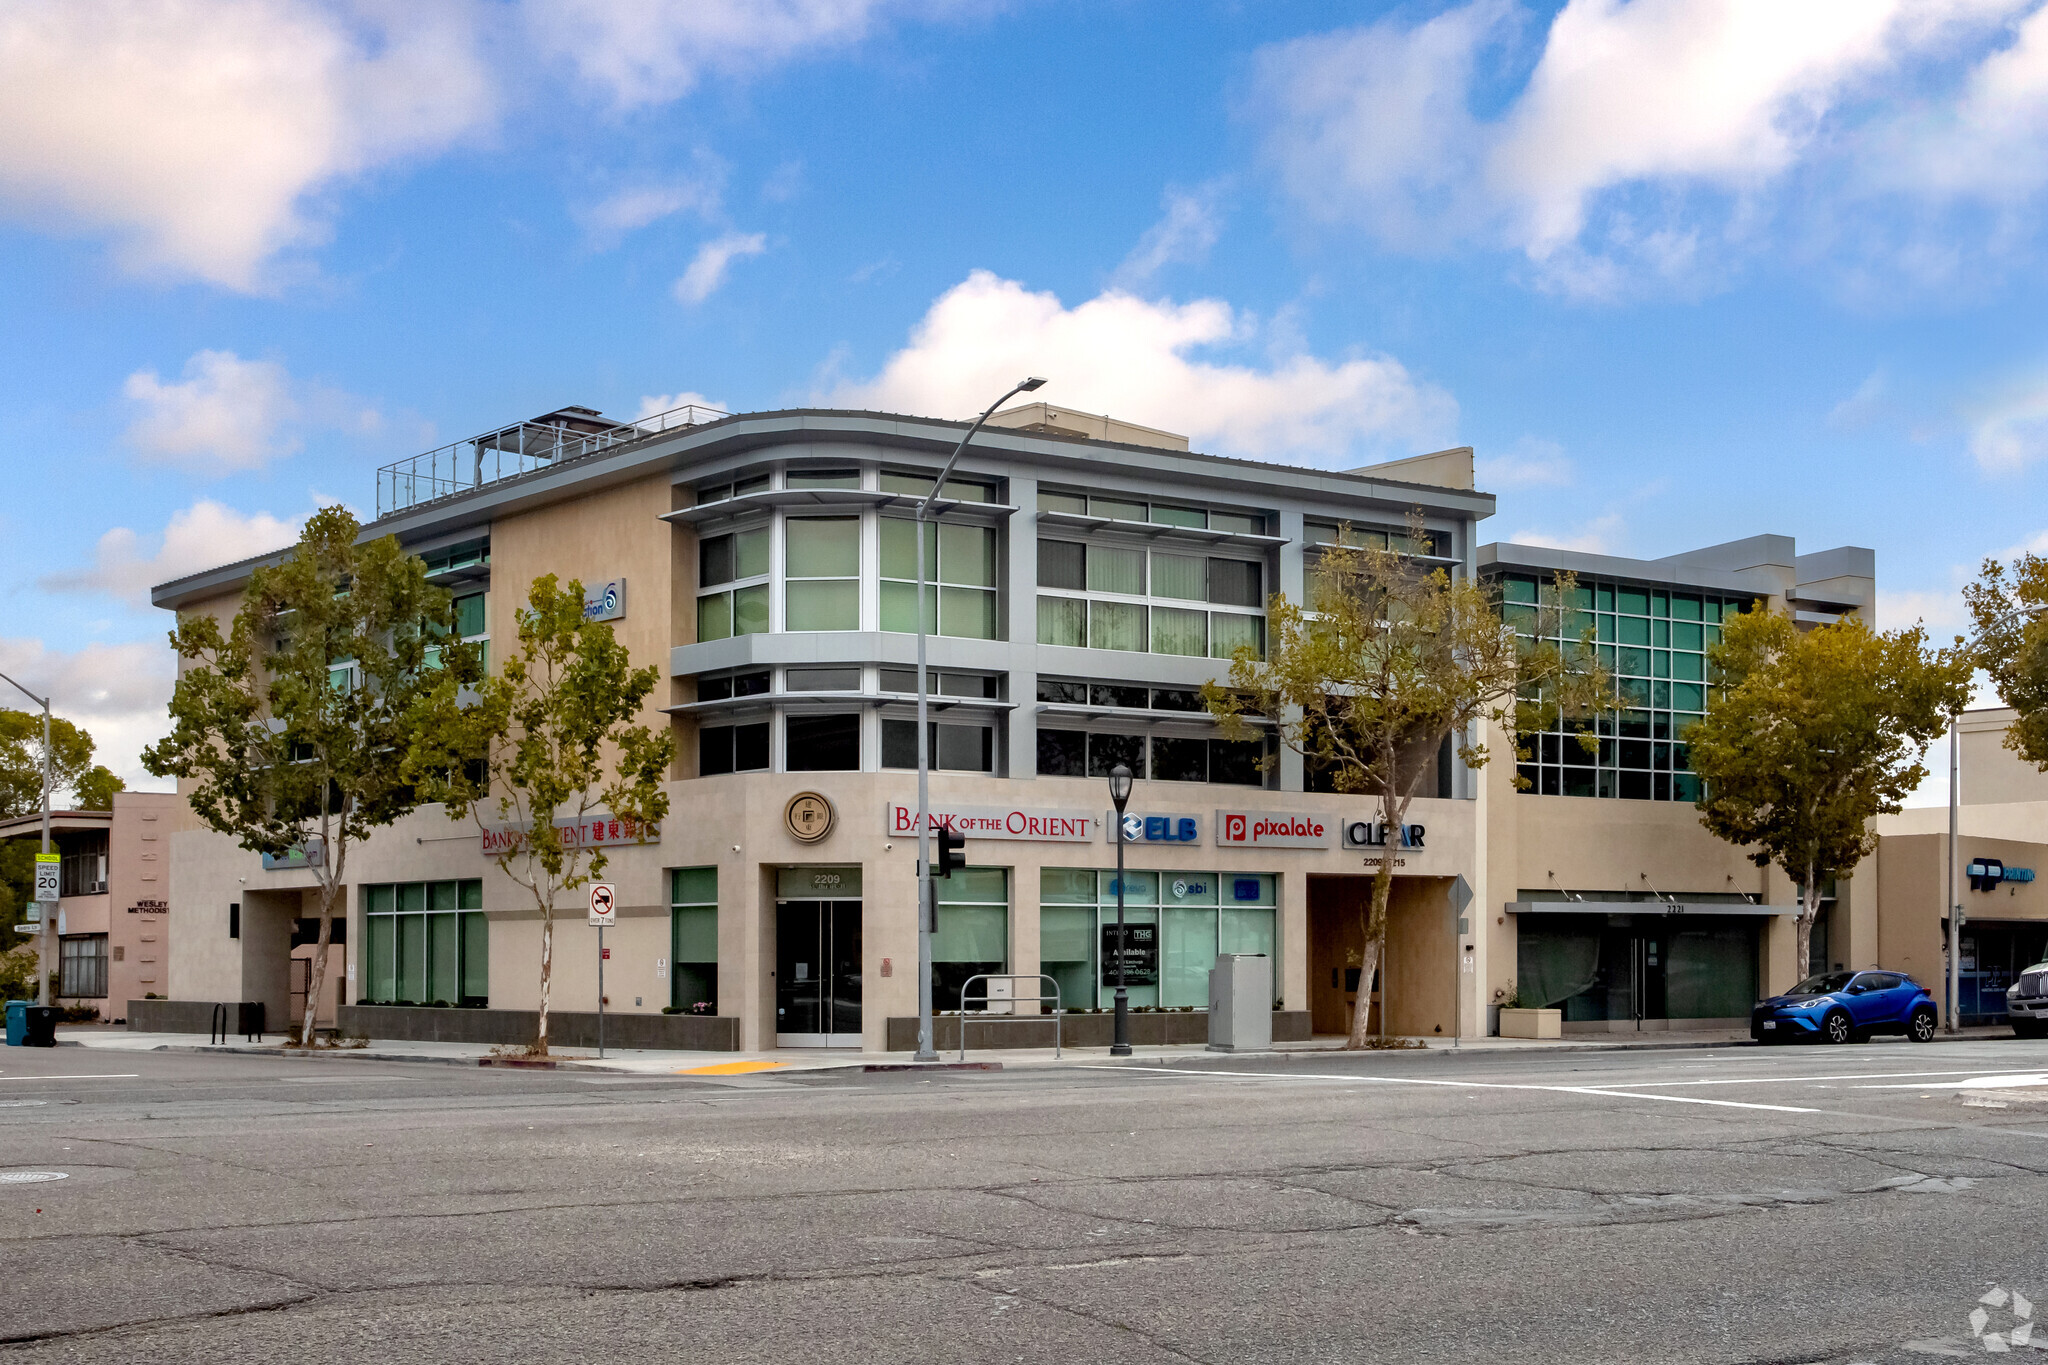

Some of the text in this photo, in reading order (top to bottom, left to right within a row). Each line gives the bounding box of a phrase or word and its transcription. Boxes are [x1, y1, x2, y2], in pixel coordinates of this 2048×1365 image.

[895, 806, 1090, 837] BANK OF THE ORIENT
[1145, 816, 1198, 842] ELB
[1253, 817, 1325, 842] pixalate
[38, 877, 57, 888] 20
[814, 874, 840, 884] 2209
[1188, 882, 1207, 894] sbi
[1667, 905, 1684, 913] 2221
